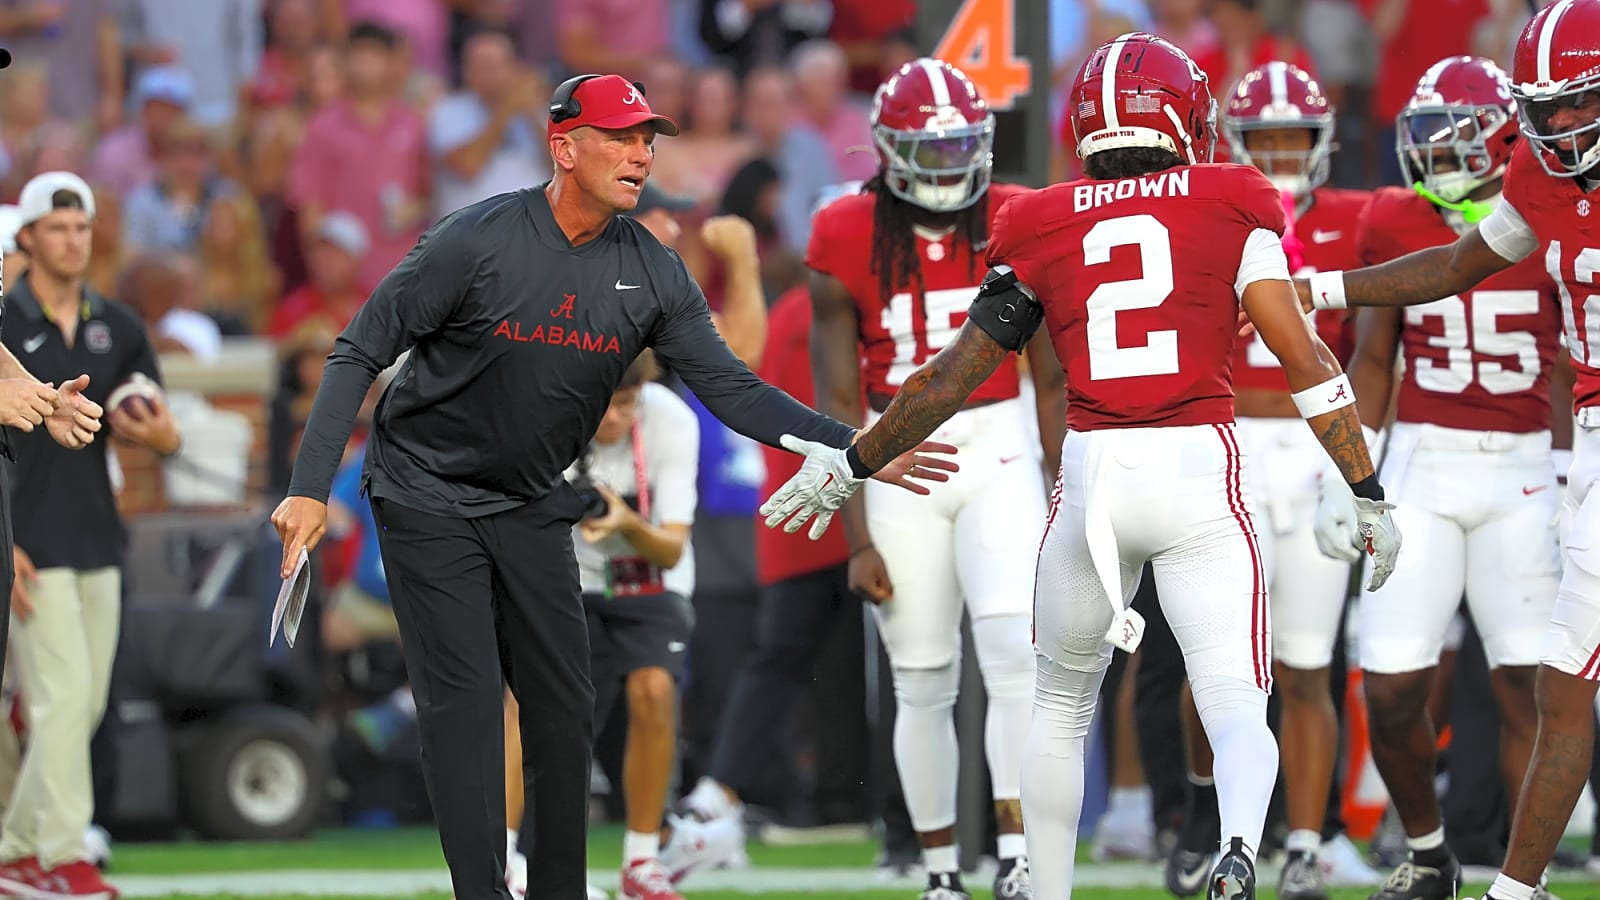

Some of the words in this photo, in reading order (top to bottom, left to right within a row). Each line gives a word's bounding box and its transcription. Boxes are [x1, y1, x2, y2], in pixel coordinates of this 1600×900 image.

[931, 0, 1032, 110] 4
[622, 83, 647, 106] A
[1073, 169, 1190, 213] BROWN
[550, 293, 577, 319] A
[1082, 214, 1180, 381] 2
[493, 319, 621, 354] ALABAMA
[1404, 290, 1541, 395] 35
[1327, 383, 1348, 403] A
